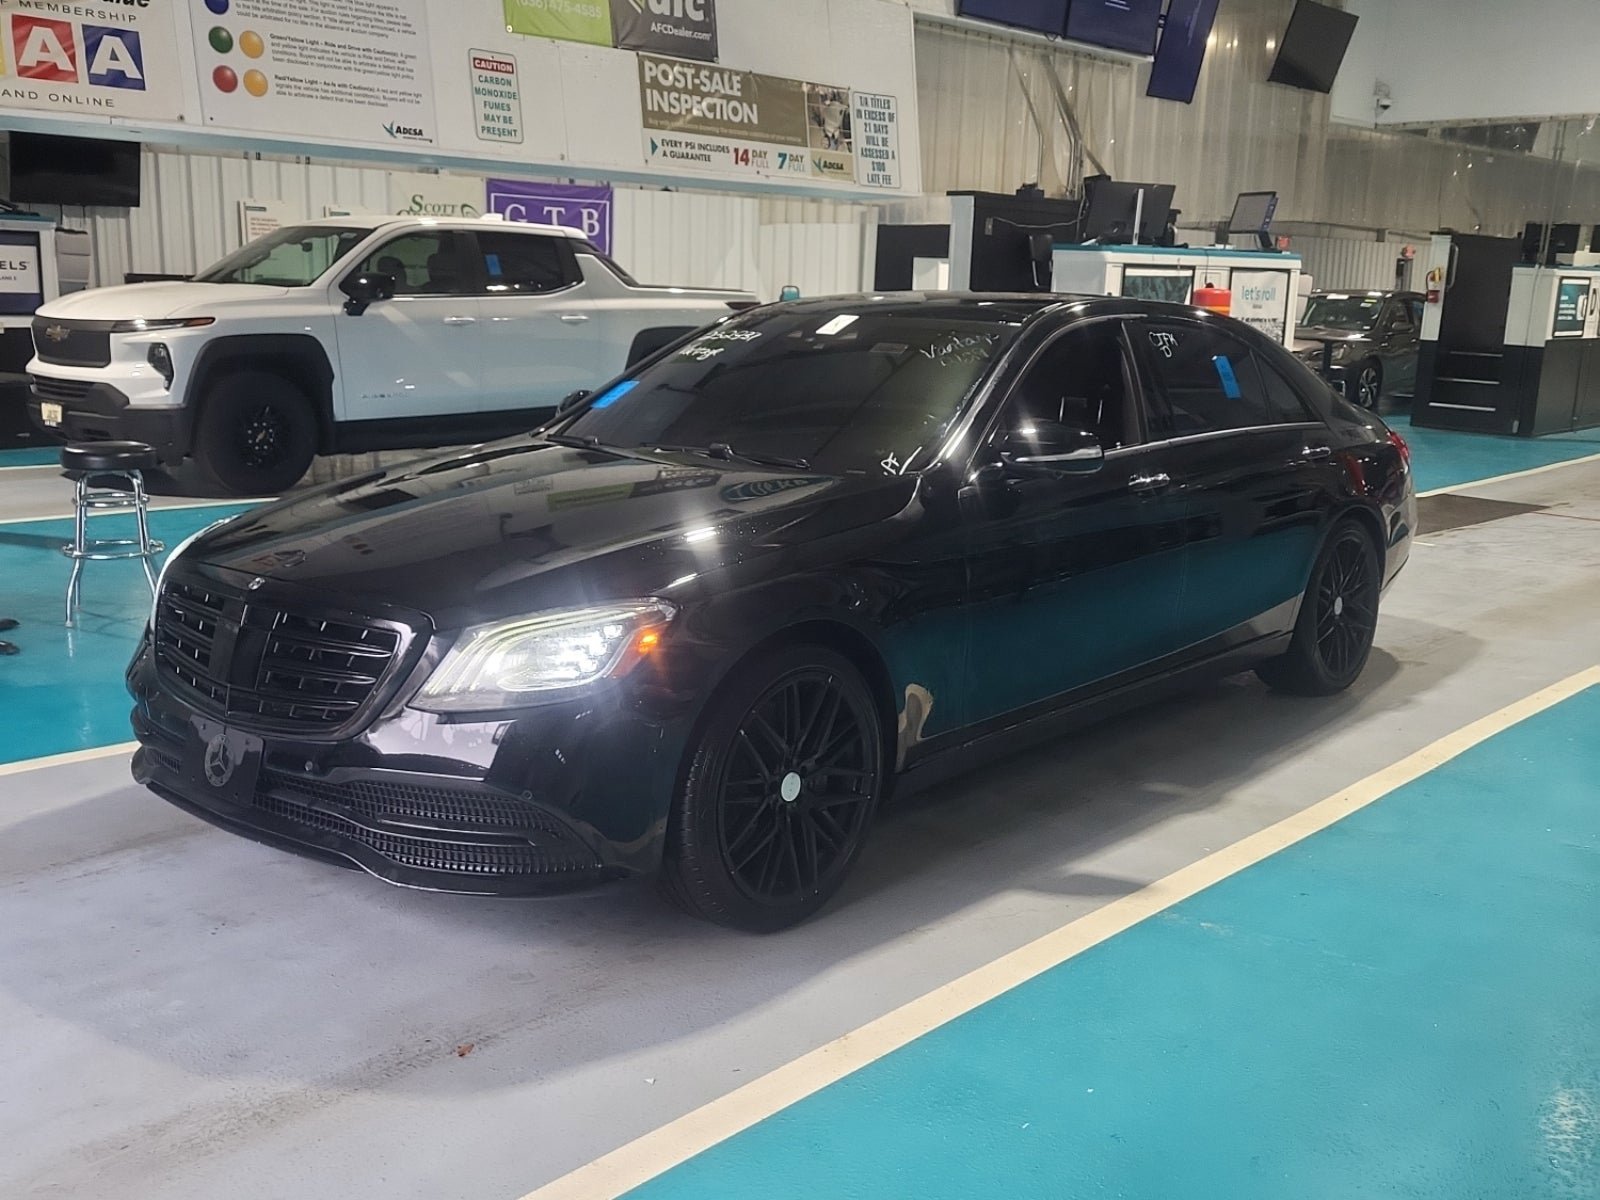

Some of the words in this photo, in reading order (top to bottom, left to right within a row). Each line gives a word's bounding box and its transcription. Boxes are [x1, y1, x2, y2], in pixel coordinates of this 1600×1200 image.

[20, 0, 137, 22] MEMBERSHIP
[650, 23, 710, 41] AFCDealer.com
[475, 59, 513, 73] CAUTION
[478, 74, 512, 87] CARBON
[643, 59, 741, 97] POST-SALE
[1, 89, 38, 100] AND
[48, 93, 115, 108] ONLINE
[474, 87, 518, 100] MONOXIDE
[483, 100, 511, 112] FUMES
[645, 88, 759, 124] INSPECTION
[484, 113, 501, 123] MAY
[502, 115, 513, 125] BE
[863, 109, 886, 122] EXCESS
[887, 112, 895, 123] OF
[481, 125, 518, 137] PRESENT
[873, 123, 889, 135] DAYS
[661, 138, 682, 149] EVERY
[684, 141, 696, 151] PSI
[697, 142, 730, 154] INCLUDES
[865, 135, 880, 147] WILL
[881, 137, 889, 147] BE
[662, 150, 668, 158] A
[669, 150, 711, 163] GUARANTEE
[733, 147, 750, 166] 14
[751, 149, 768, 160] DAY
[788, 154, 804, 164] DAY
[860, 147, 889, 160] ASSESSED
[891, 150, 896, 160] A
[751, 159, 769, 169] FULL
[777, 152, 787, 170] 7
[788, 163, 806, 173] FULL
[867, 173, 881, 185] LATE
[881, 174, 893, 186] FEE
